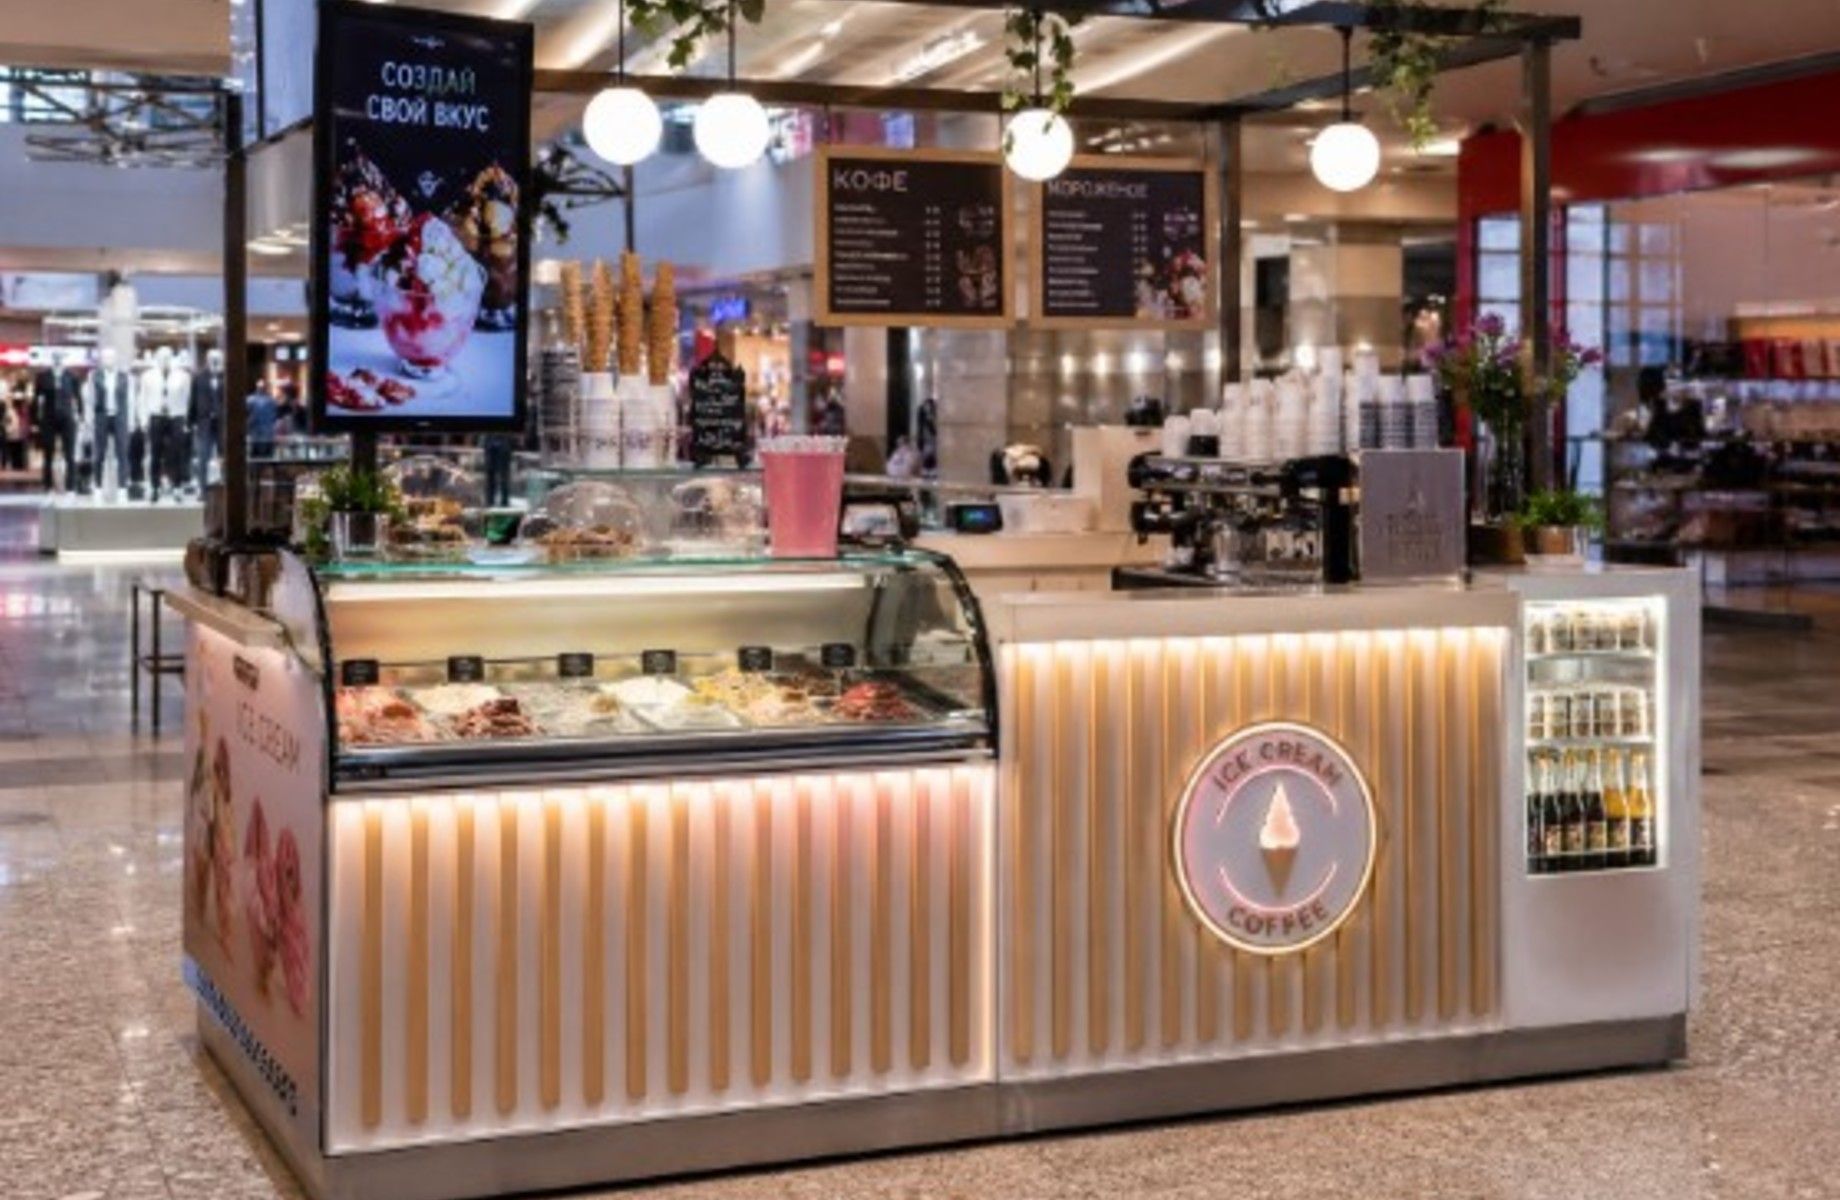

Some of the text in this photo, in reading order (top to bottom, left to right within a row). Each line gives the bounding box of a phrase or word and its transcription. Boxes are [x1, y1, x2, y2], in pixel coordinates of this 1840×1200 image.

[382, 61, 475, 95] СОЗДАЙ
[367, 94, 489, 132] СВОЙ ВКУС
[833, 168, 908, 192] КОФЕ
[1213, 740, 1344, 791] ICE CREAM
[1228, 901, 1330, 937] COFFEE
